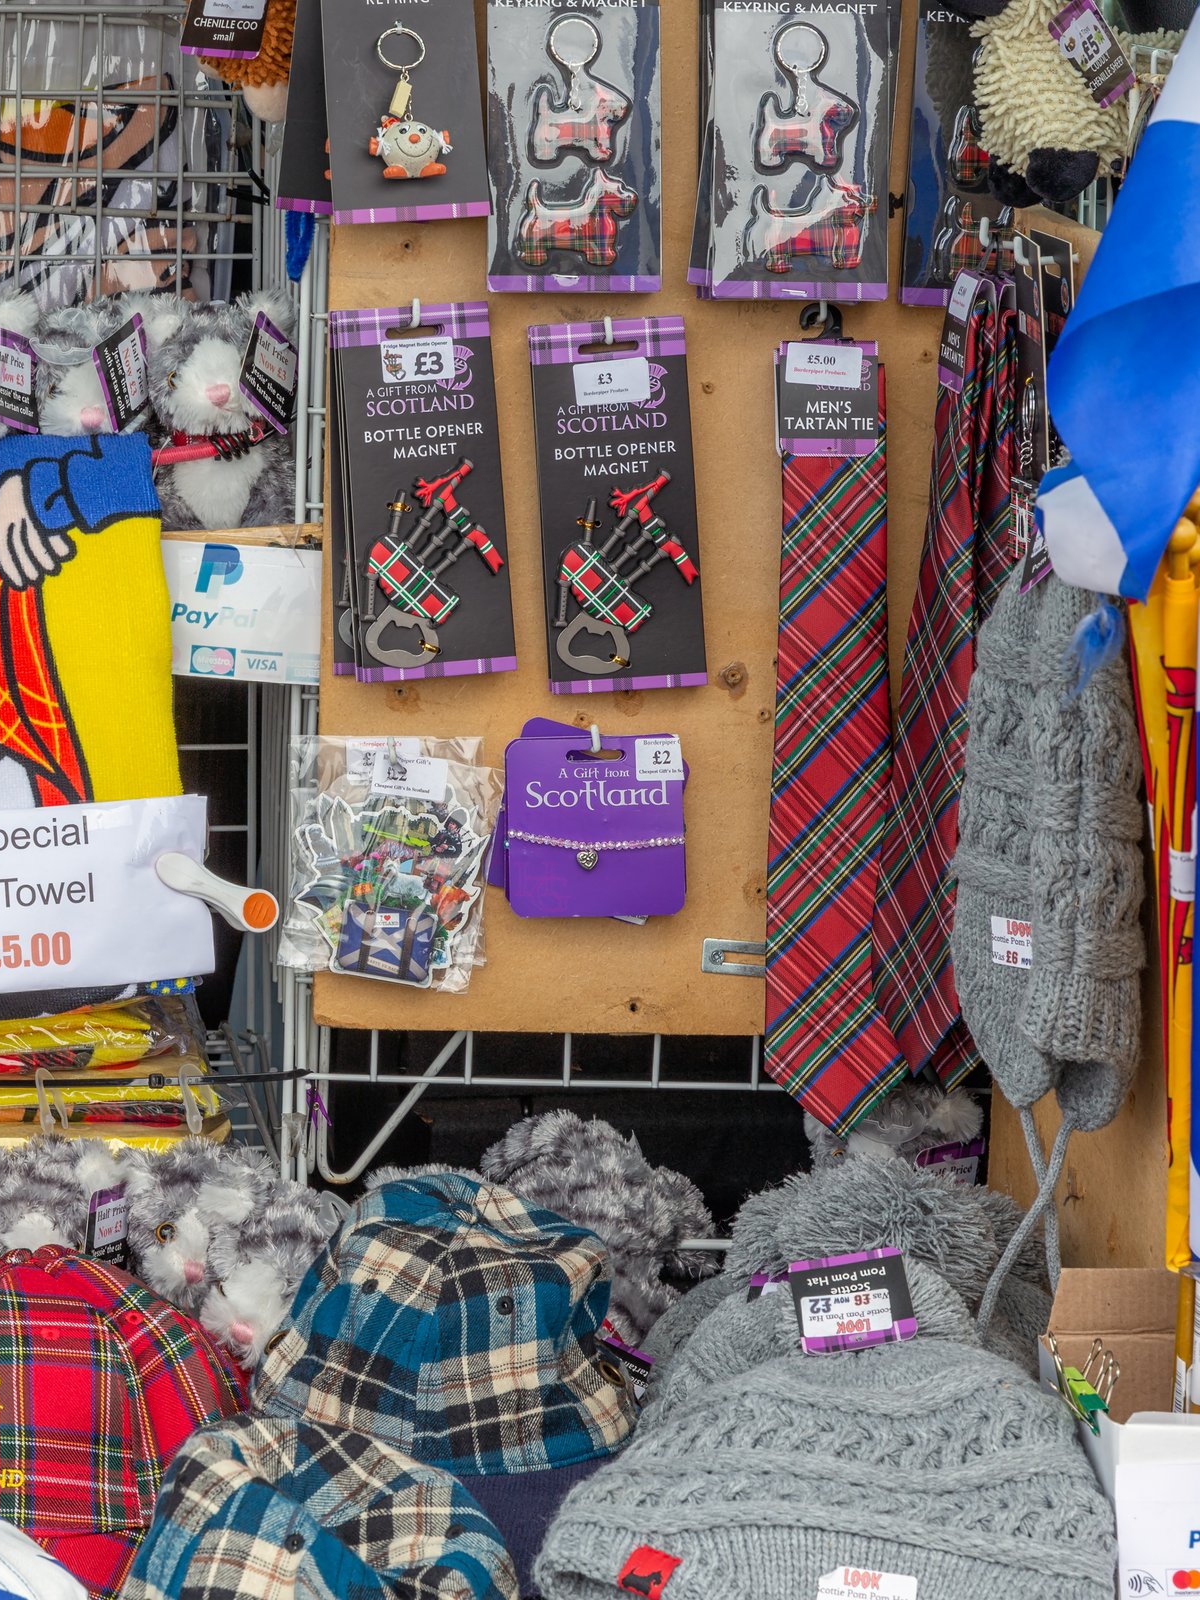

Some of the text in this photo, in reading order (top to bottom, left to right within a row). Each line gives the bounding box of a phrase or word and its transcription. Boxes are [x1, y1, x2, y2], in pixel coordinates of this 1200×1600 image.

[723, 2, 878, 15] KEYRING & MAGNET
[193, 17, 258, 31] CHENILLE COO
[212, 32, 235, 42] small
[414, 351, 444, 376] £3
[807, 354, 836, 366] £5.00
[276, 367, 287, 382] £3
[597, 372, 613, 385] £3
[109, 368, 120, 397] tartan
[116, 396, 126, 420] collar
[366, 384, 438, 398] A GIFT FROM
[366, 393, 474, 417] SCOTLAND
[557, 403, 630, 416] A GIFT FROM
[805, 400, 852, 414] MEN'S
[557, 412, 668, 435] SCOTLAND
[784, 416, 874, 431] TARTAN TIE
[364, 422, 484, 443] BOTTLE OPENER
[393, 442, 457, 459] MAGNET
[554, 440, 677, 461] BOTTLE OPENER
[584, 460, 649, 477] MAGNET
[246, 657, 278, 672] VISA
[643, 739, 676, 747] Borderpiper
[652, 750, 671, 765] £2
[558, 767, 630, 780] A Gift from
[525, 780, 670, 811] Scotland
[806, 1266, 887, 1288] Pom Pom Hat
[830, 1281, 871, 1295] Scottie
[808, 1297, 832, 1314] £2
[854, 1293, 871, 1307] £6
[809, 1314, 824, 1323] Hat
[826, 1312, 845, 1321] Pom
[845, 1310, 865, 1319] Pom
[836, 1318, 871, 1335] LOOK
[843, 1567, 883, 1590] LOOK
[847, 1588, 867, 1600] Pom
